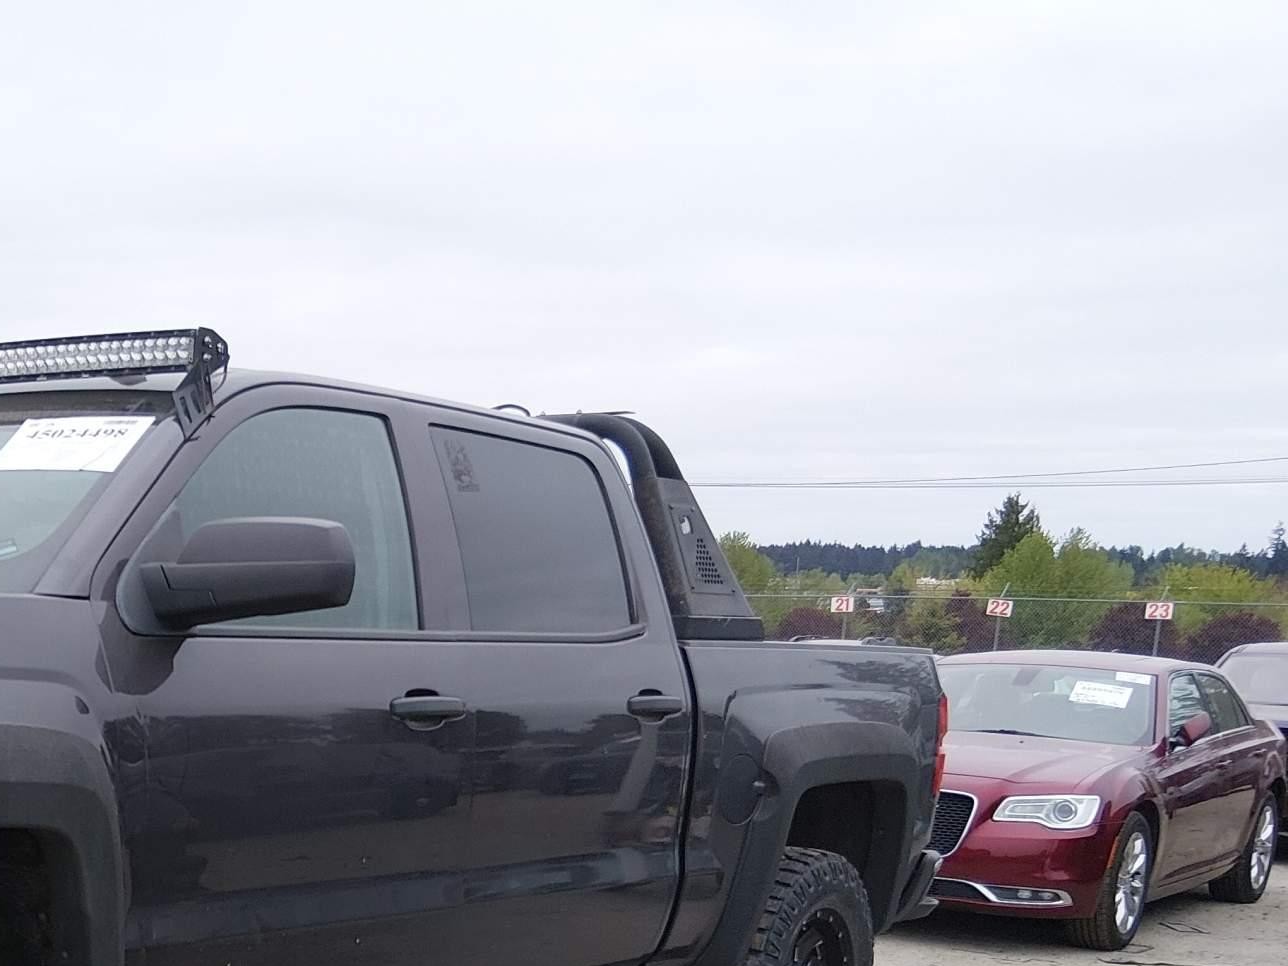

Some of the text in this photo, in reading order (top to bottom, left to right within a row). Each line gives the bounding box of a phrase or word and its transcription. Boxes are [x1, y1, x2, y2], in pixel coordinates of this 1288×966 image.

[26, 428, 128, 440] 45024498
[835, 598, 851, 612] 21
[988, 600, 1010, 616] 22
[1147, 604, 1170, 619] 23
